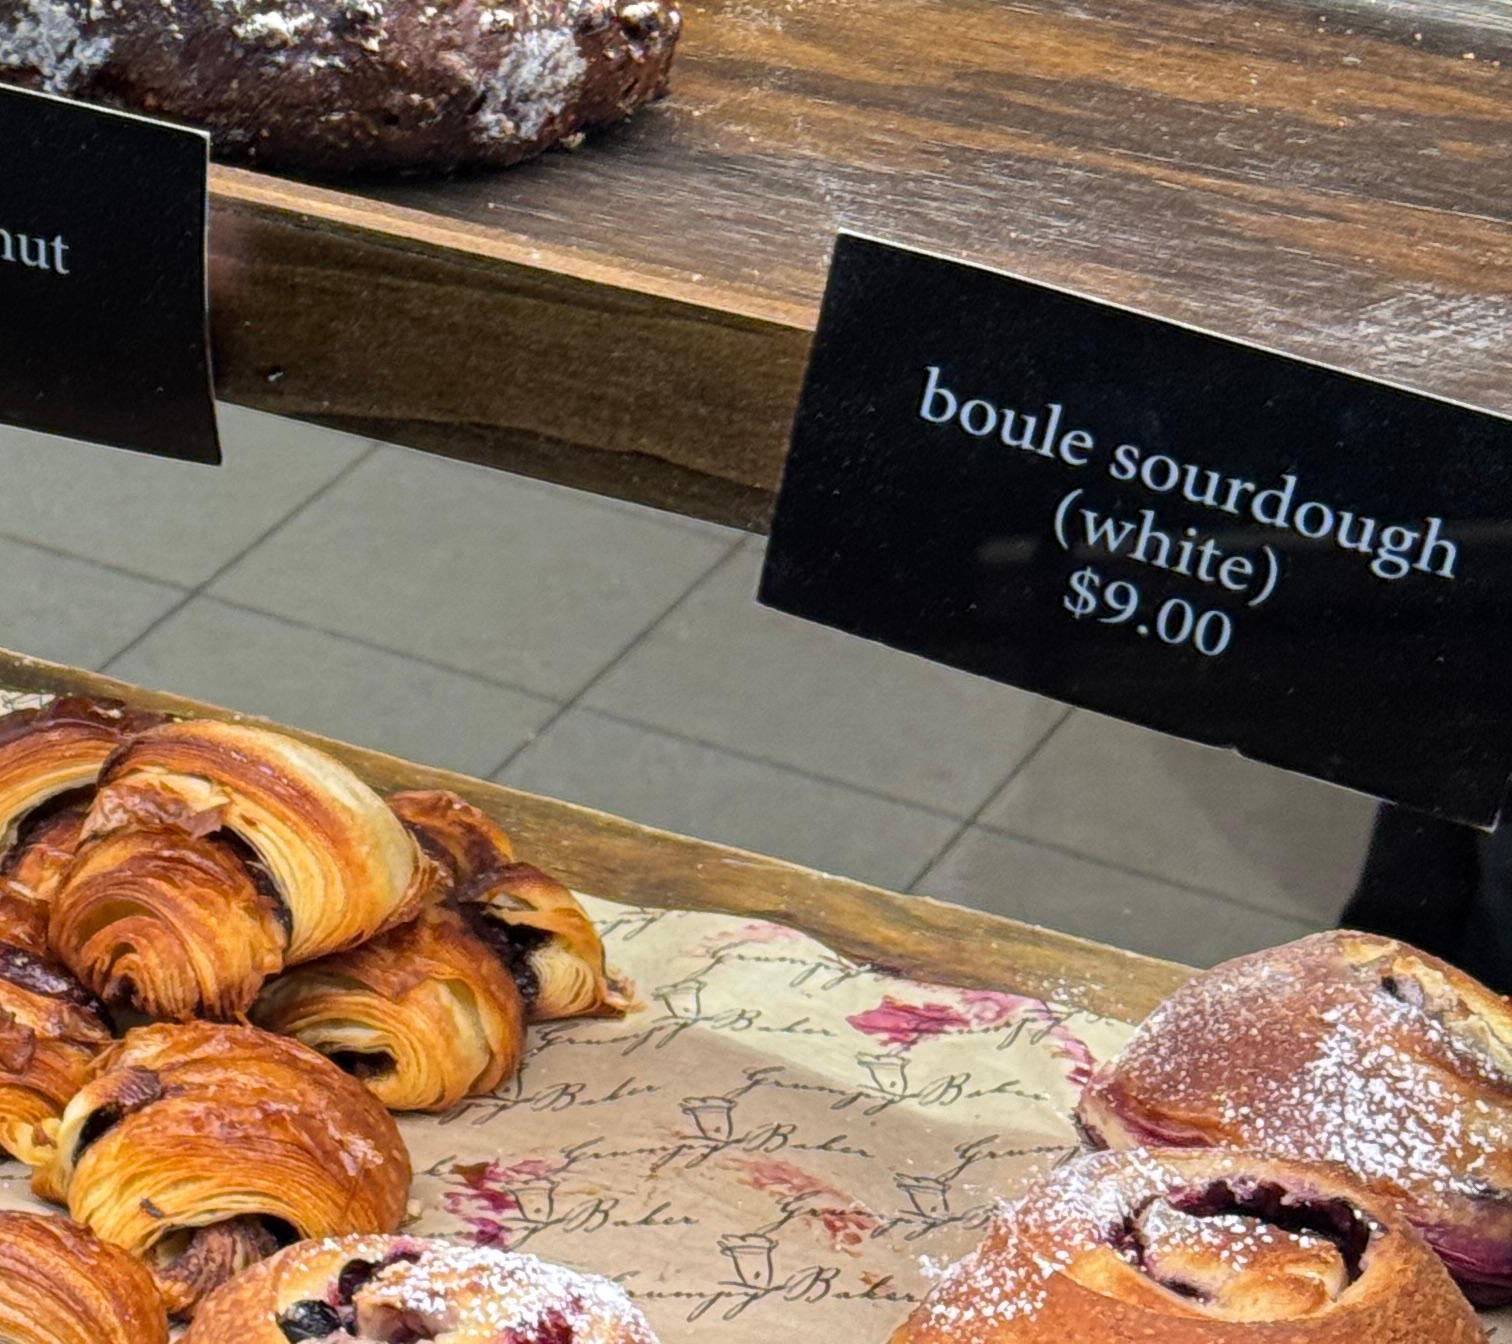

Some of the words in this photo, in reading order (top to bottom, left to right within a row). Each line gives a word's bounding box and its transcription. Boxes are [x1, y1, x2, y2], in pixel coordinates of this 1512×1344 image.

[917, 366, 1093, 467] boule
[1109, 444, 1458, 579] sourdough
[1053, 488, 1280, 607] (white)
[1063, 566, 1232, 656] $9.00
